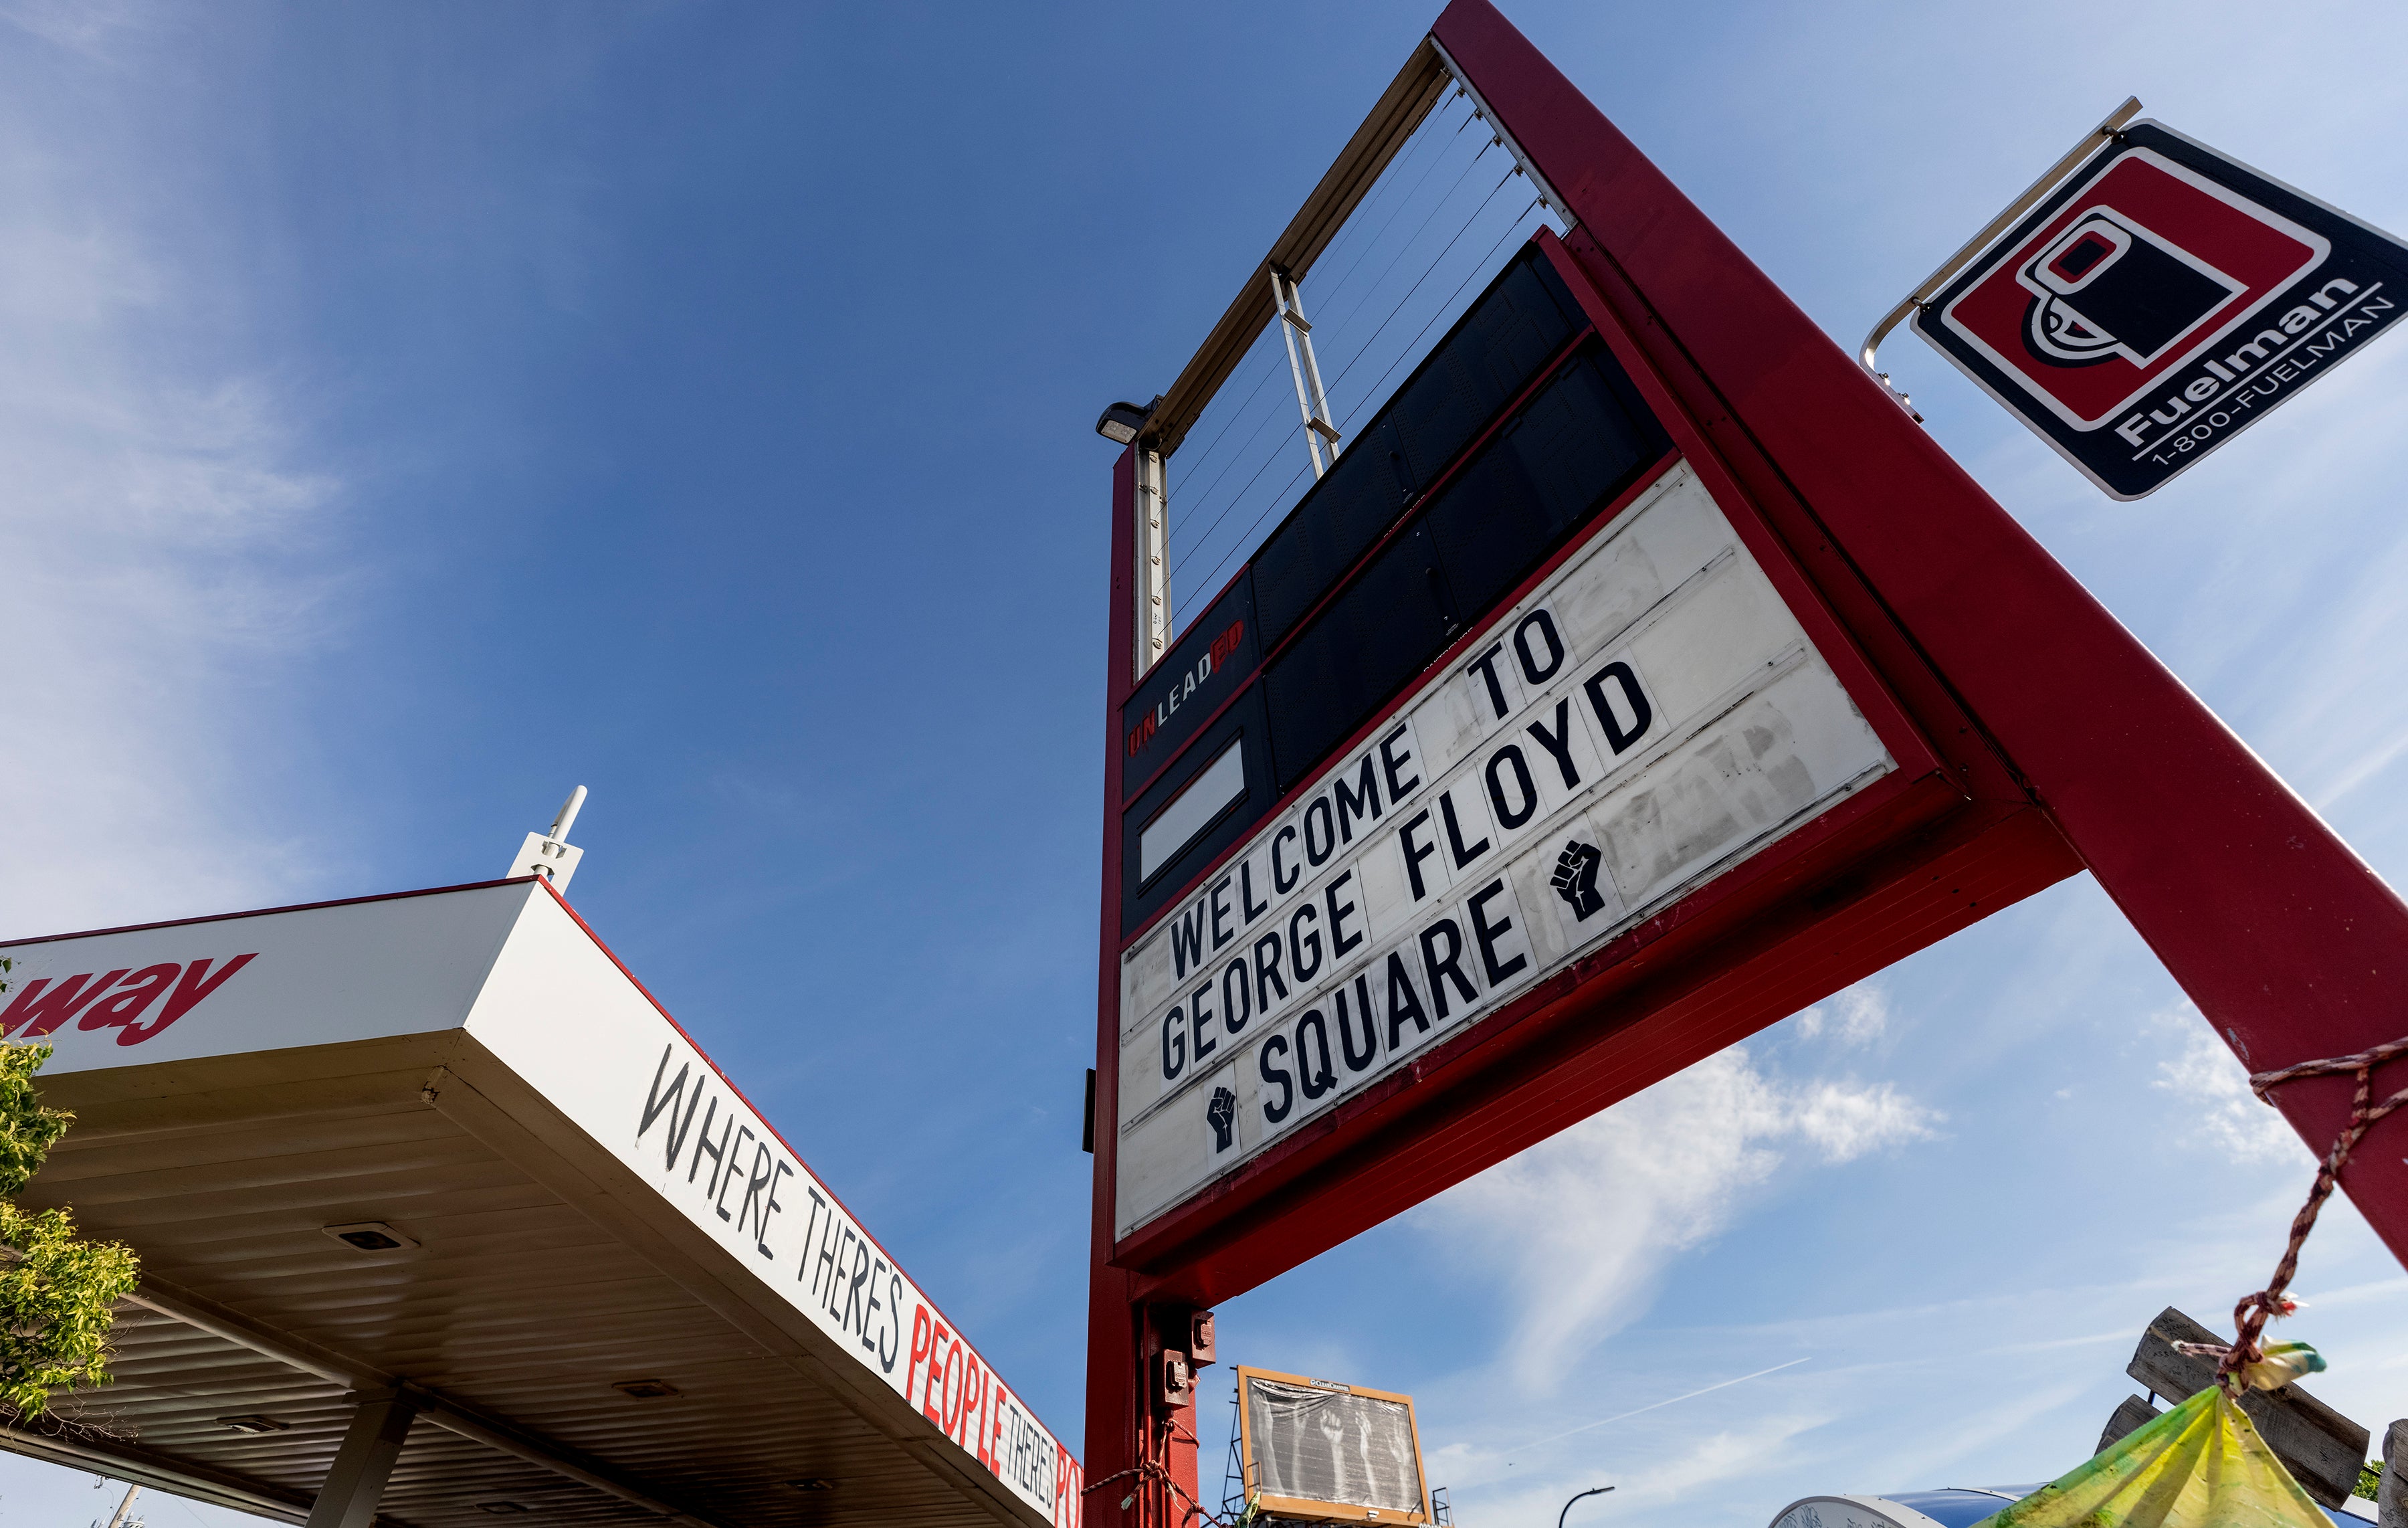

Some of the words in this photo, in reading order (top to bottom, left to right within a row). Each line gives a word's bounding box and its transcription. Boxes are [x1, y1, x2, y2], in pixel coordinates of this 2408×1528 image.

[2114, 278, 2359, 448] Fuelman
[2152, 296, 2395, 466] 1-800-FUELMAN
[1162, 869, 1363, 1080] GEORGE
[1399, 661, 1652, 903] FLOYD
[1171, 725, 1420, 981] WELCOME
[1467, 609, 1565, 720] TO
[1259, 877, 1527, 1124] SQUARE
[637, 1043, 794, 1260] WHERE
[798, 1185, 903, 1375] THERE'S
[905, 1303, 1007, 1480] PEOPLE
[1008, 1404, 1055, 1510] THERE'S
